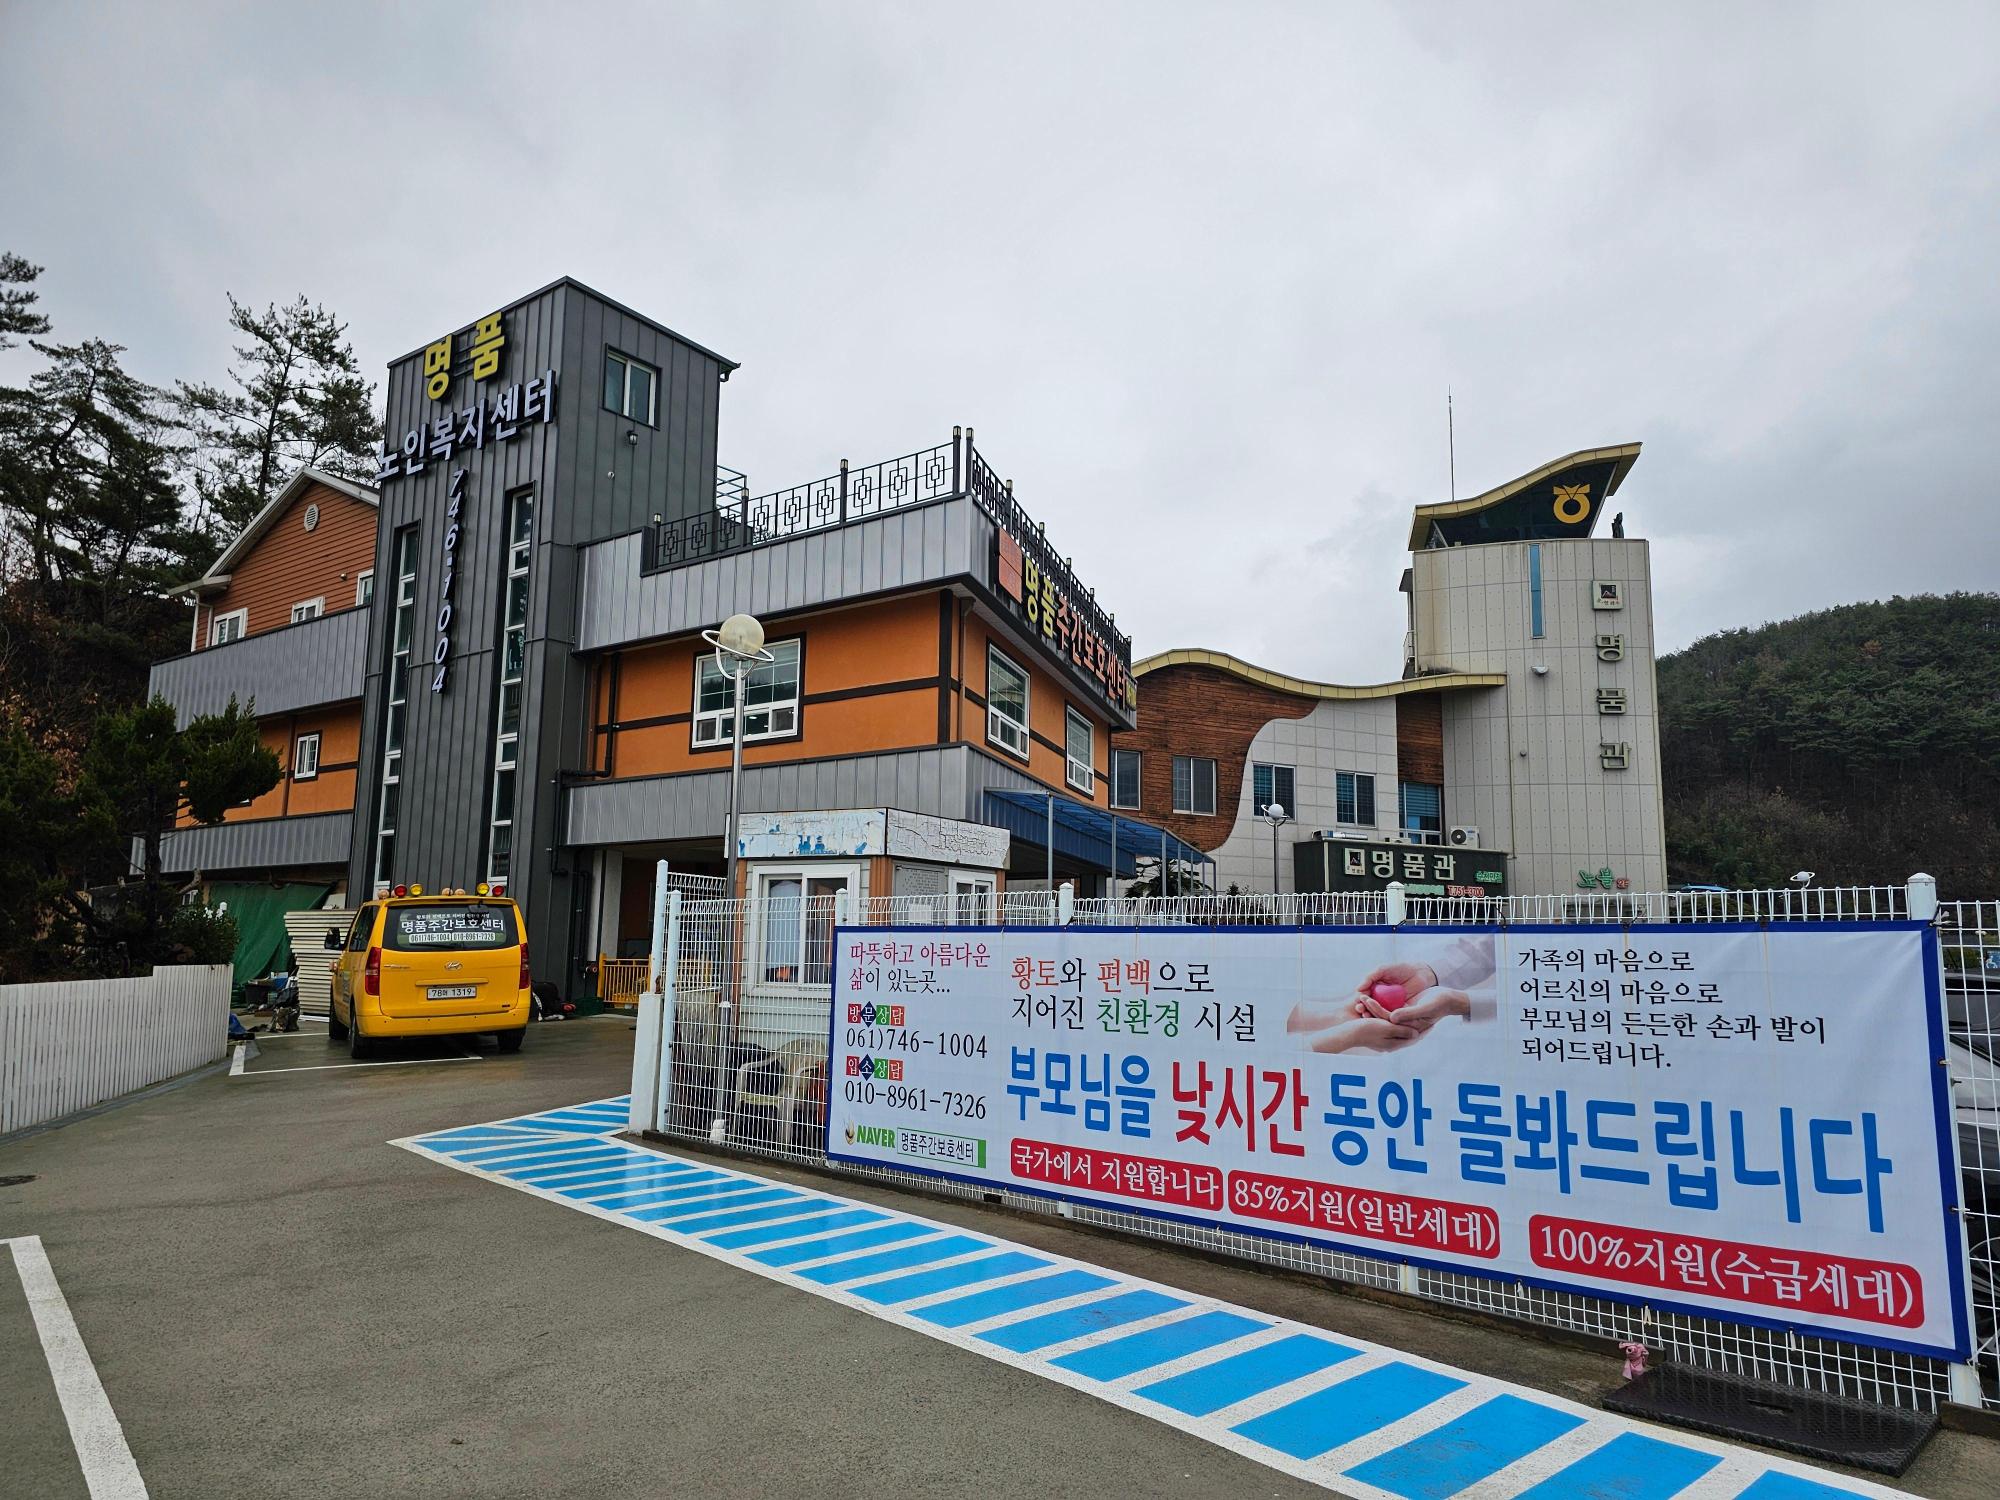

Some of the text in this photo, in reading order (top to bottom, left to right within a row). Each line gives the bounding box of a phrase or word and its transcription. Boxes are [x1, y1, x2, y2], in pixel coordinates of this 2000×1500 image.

[422, 312, 505, 400] 명품
[375, 369, 555, 480] 노인복지센터
[431, 468, 467, 694] 746-1004
[1596, 633, 1632, 770] 명품관
[1372, 850, 1456, 881] 명품관
[401, 919, 504, 933] 명품주간보호센터
[850, 942, 990, 968] 따뜻하고 아름다운
[1518, 948, 1695, 974] 가족의 마음으로
[849, 968, 880, 991] 삶이
[1011, 956, 1215, 995] 황토와 편백으로
[452, 987, 472, 996] 1319
[1519, 978, 1723, 1005] 어르신의 마음으로
[848, 1003, 905, 1026] 방문상담
[1012, 994, 1256, 1042] 지어진 친환경 시설
[1520, 1008, 1826, 1044] 부모님의 든든한 손과 발이
[846, 1028, 988, 1058] 061)746-1004
[1522, 1037, 1672, 1068] 되어드립니다.
[847, 1057, 903, 1081] 입소상담
[845, 1080, 986, 1119] 010-8961-7326
[856, 1125, 896, 1149] NAVER
[901, 1132, 974, 1162] 명품주간보호센터
[1006, 1046, 1893, 1233] 부모님을 낮시간 동안 돌봐드립니다
[1014, 1144, 1220, 1205] 국가에서 지원합니다
[1234, 1178, 1497, 1252] 85%지원(일반세대)
[1540, 1224, 1913, 1318] 100%지원(수급세대)
